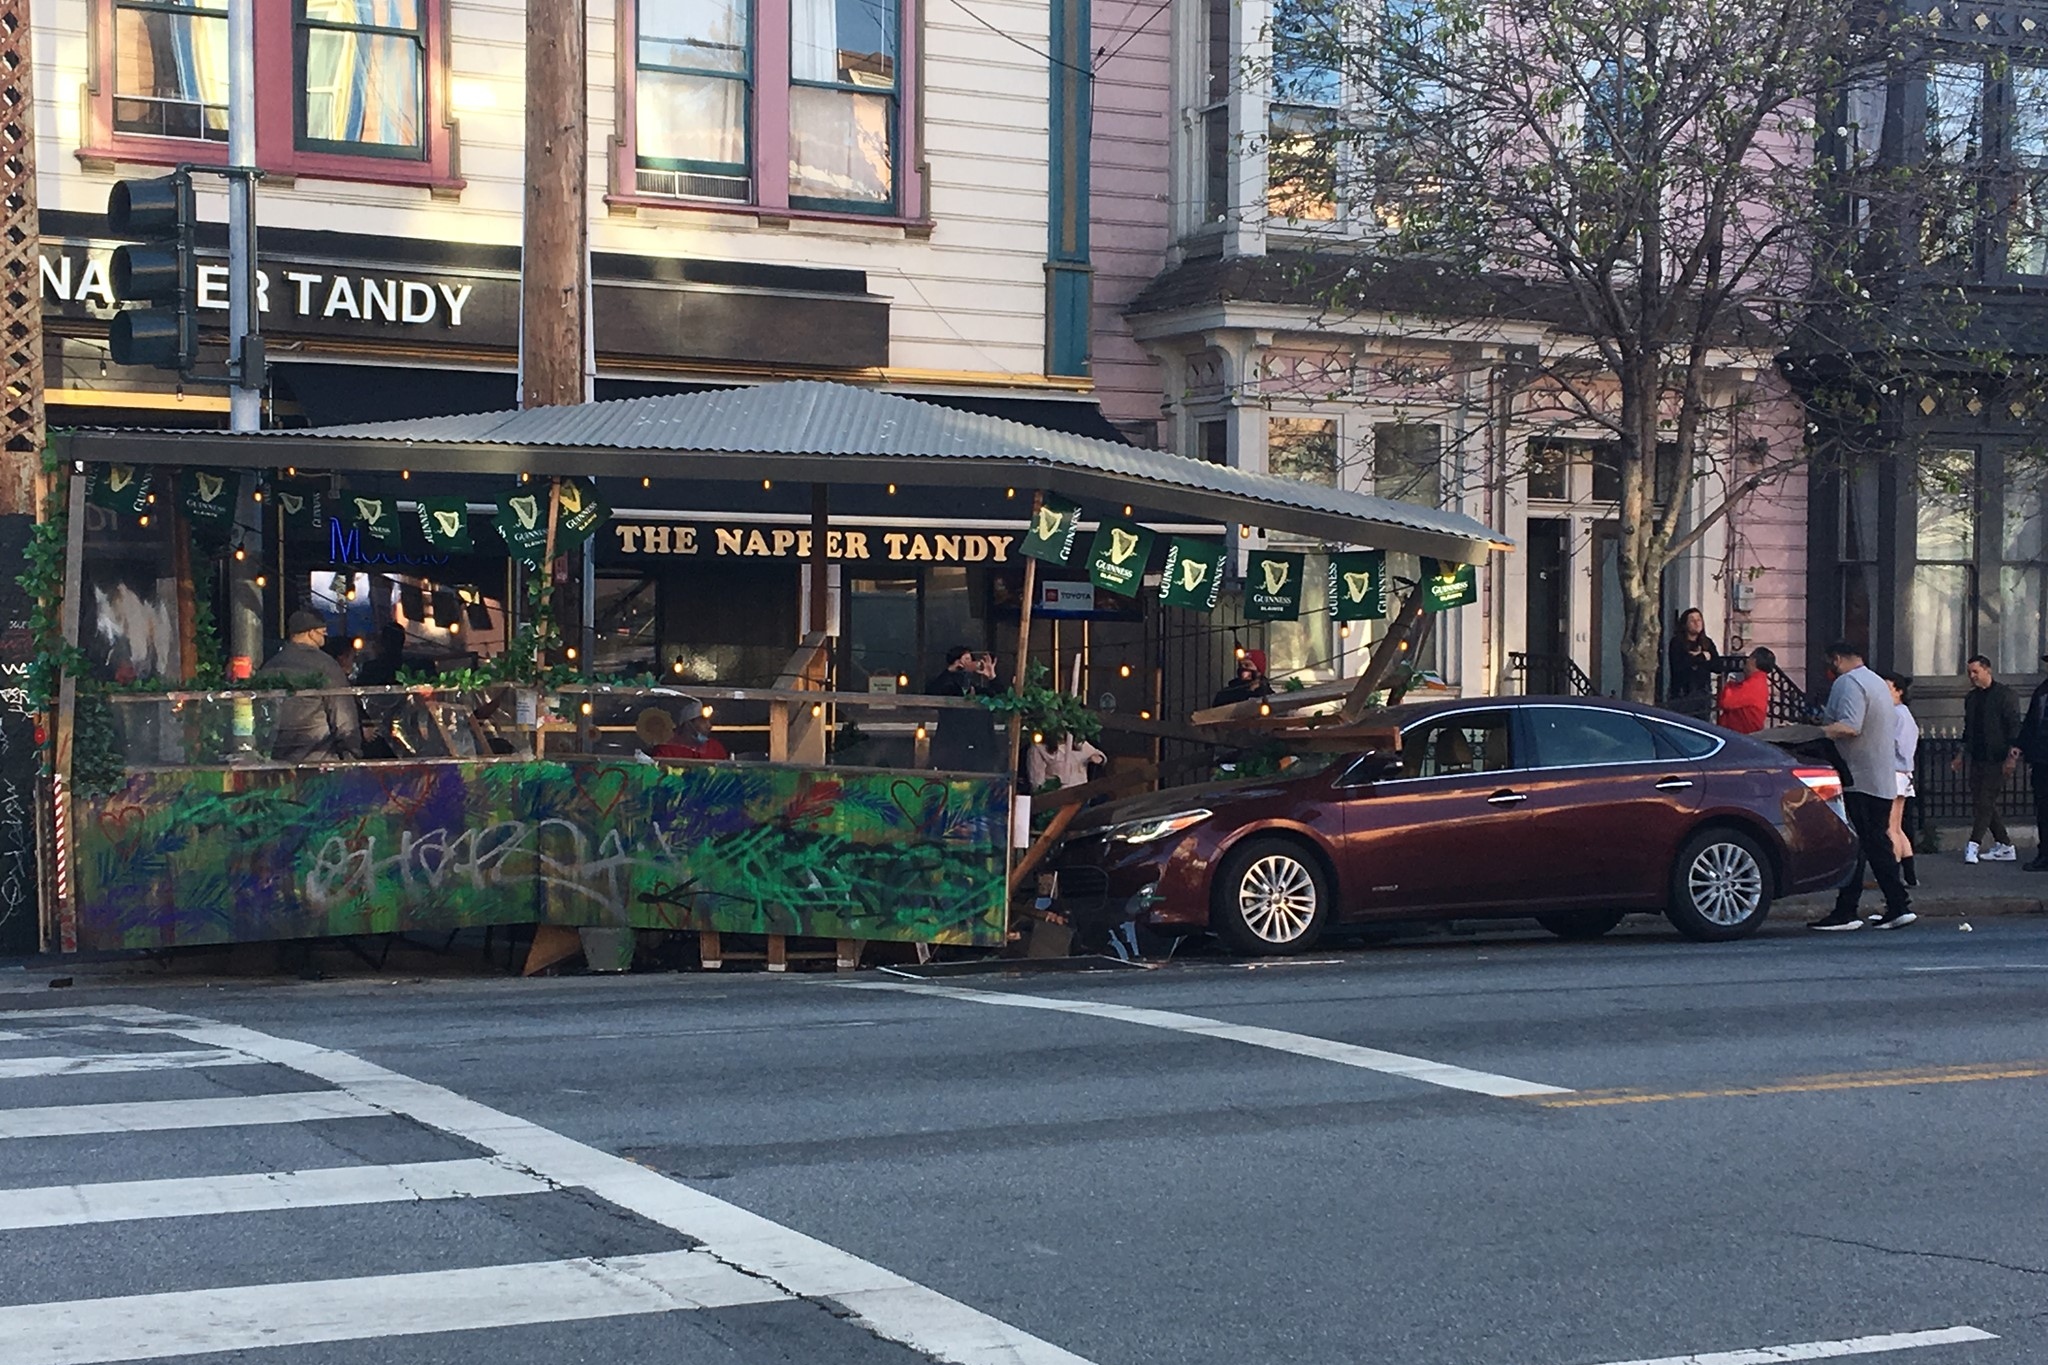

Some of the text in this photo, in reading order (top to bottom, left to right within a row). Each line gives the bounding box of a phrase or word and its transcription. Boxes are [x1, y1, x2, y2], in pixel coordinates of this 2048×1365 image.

[287, 271, 473, 326] TANDY
[565, 501, 598, 530] GUINNESS
[1059, 506, 1082, 561] GUINNESS
[514, 528, 549, 542] GUINNES
[615, 525, 699, 554] THE
[883, 533, 1014, 562] TANDY
[1095, 559, 1133, 579] GUINNESS
[1158, 544, 1179, 600] GUINNESS
[1206, 555, 1227, 609] GUINNESS
[1377, 560, 1387, 614] GUINNESS
[1060, 591, 1092, 600] TOYOTA
[1253, 593, 1292, 605] GUINNESS
[1328, 562, 1339, 617] GUINNESS
[1431, 580, 1469, 596] GUINNESS
